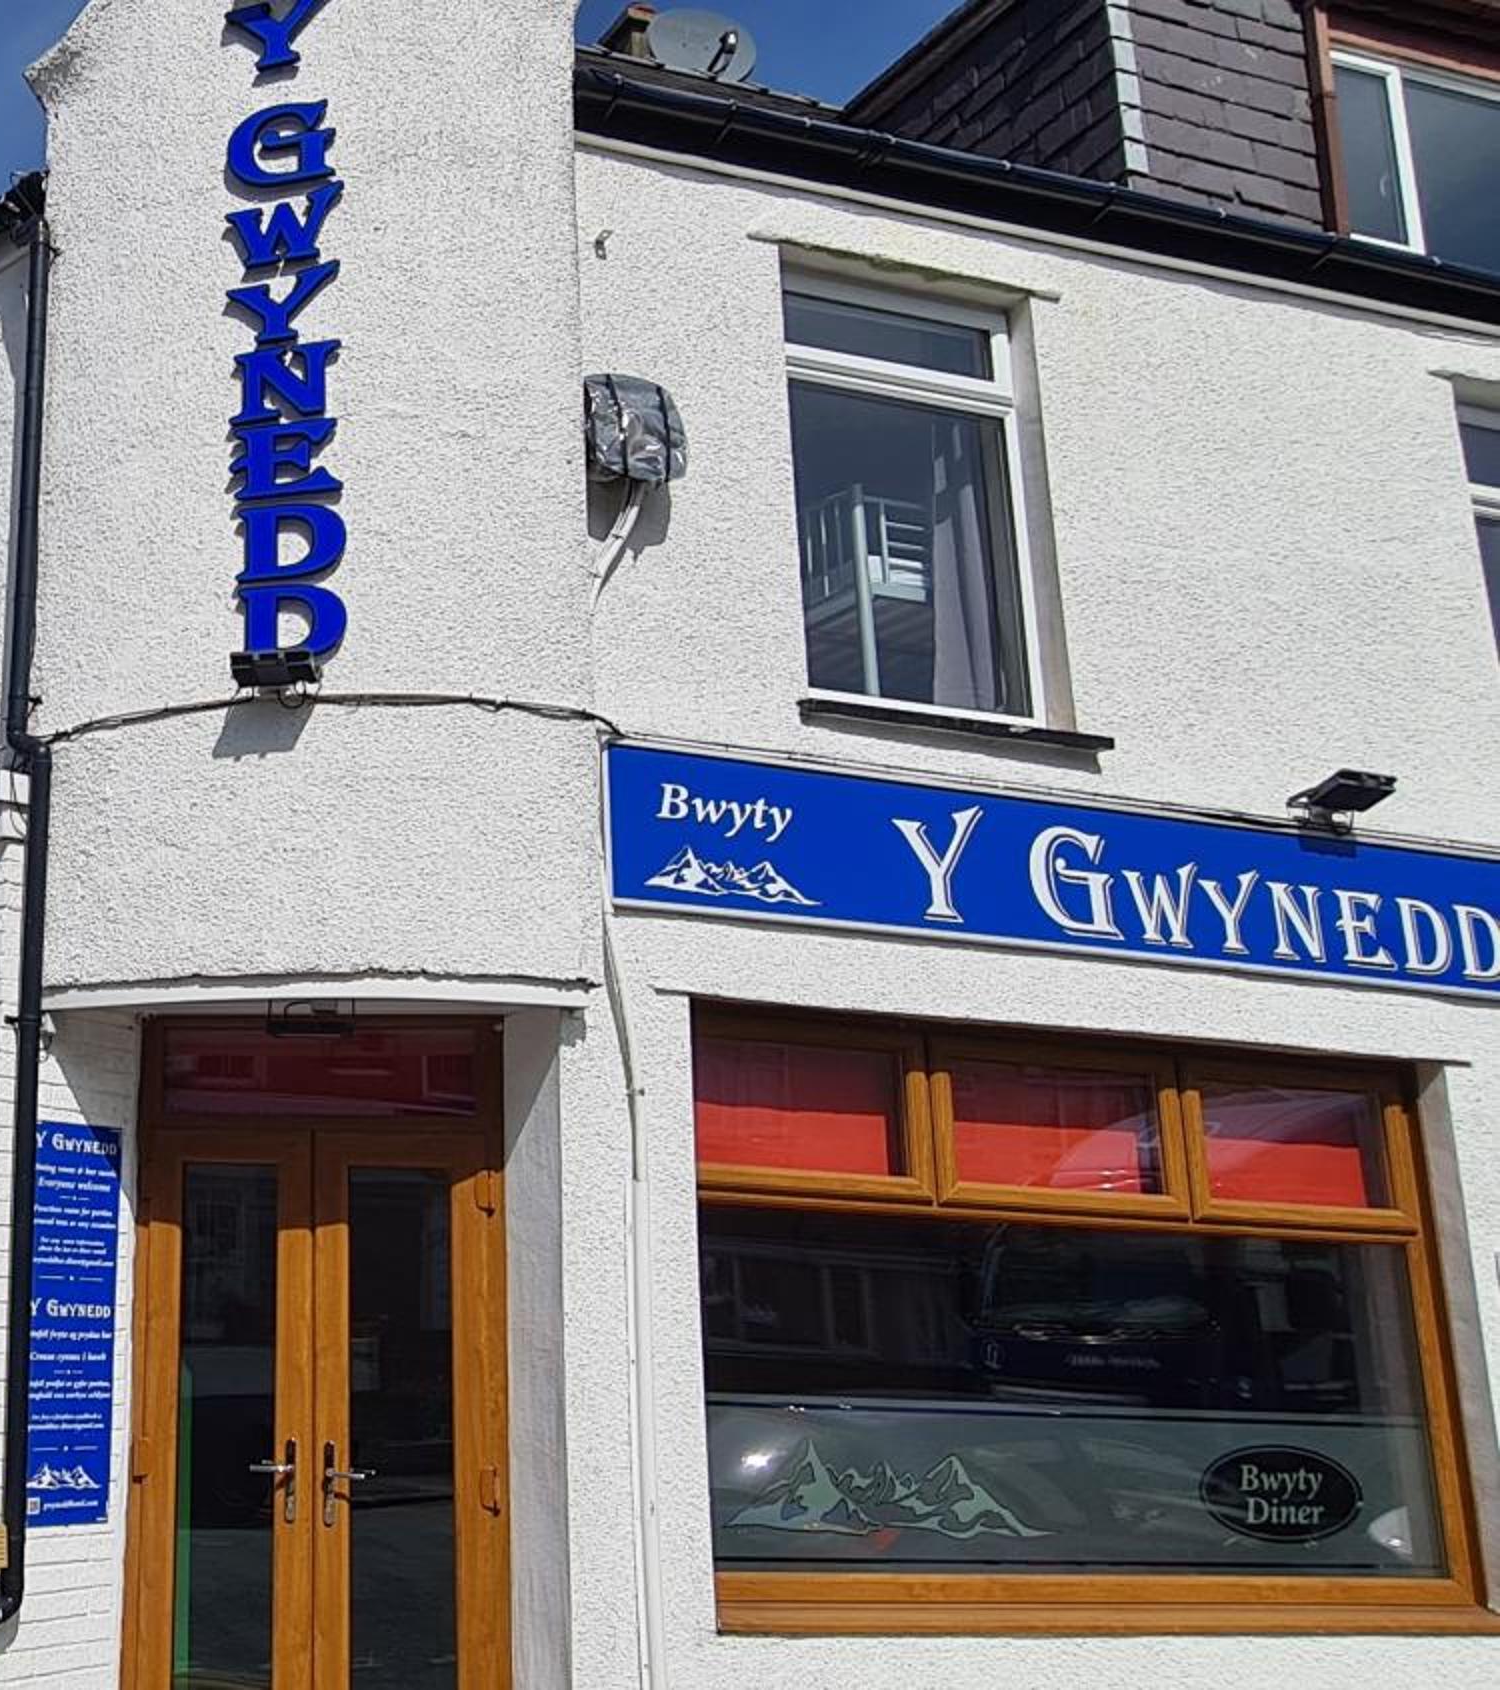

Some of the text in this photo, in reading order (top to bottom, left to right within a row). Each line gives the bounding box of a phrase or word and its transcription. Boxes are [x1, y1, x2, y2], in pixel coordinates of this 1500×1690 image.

[224, 0, 348, 656] Y GWYNEDD
[657, 783, 793, 842] Bwyty
[891, 805, 1500, 981] Y GWYNEDD
[36, 1130, 117, 1155] Y GWYNEDD
[30, 1297, 111, 1319] Y GWYNEDD
[1238, 1464, 1324, 1500] Bwyty
[1246, 1496, 1325, 1525] Diner
